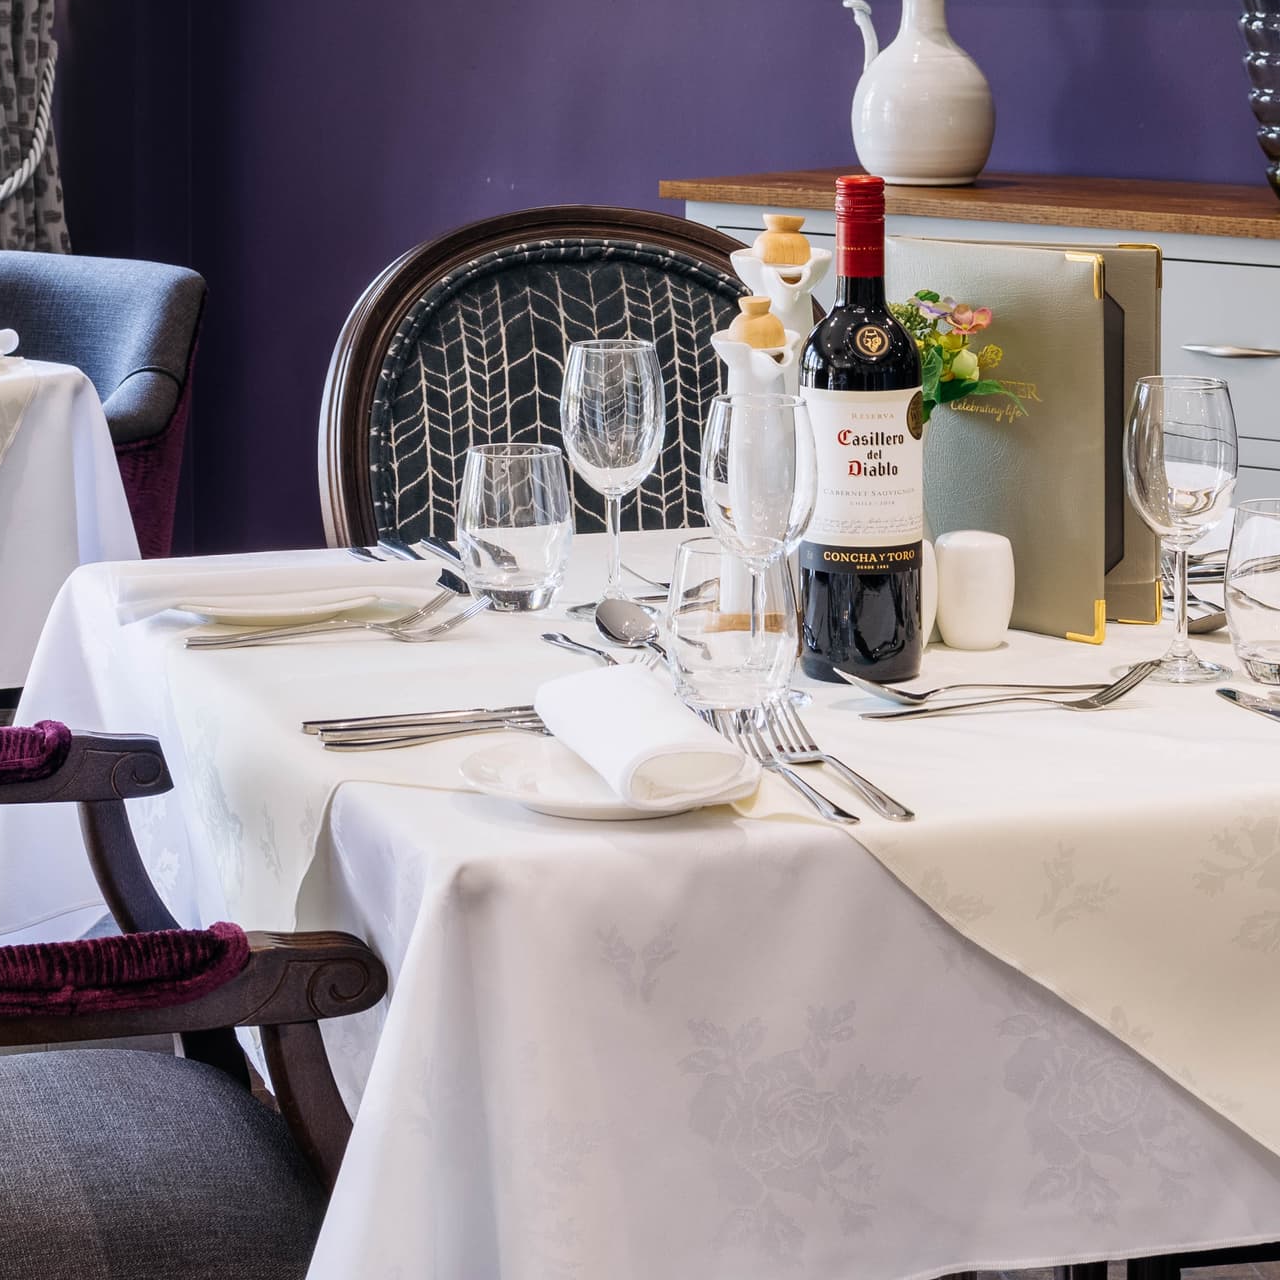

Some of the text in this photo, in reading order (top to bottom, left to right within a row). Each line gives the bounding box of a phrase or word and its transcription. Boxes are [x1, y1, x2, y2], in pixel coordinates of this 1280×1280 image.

[851, 412, 895, 420] RESERVA
[950, 399, 1004, 422] Celebrating
[837, 428, 904, 446] Casillero
[866, 449, 882, 460] del
[848, 460, 898, 477] Diablo
[823, 551, 877, 563] CONCHA
[879, 553, 886, 561] Y
[887, 549, 915, 562] TORO
